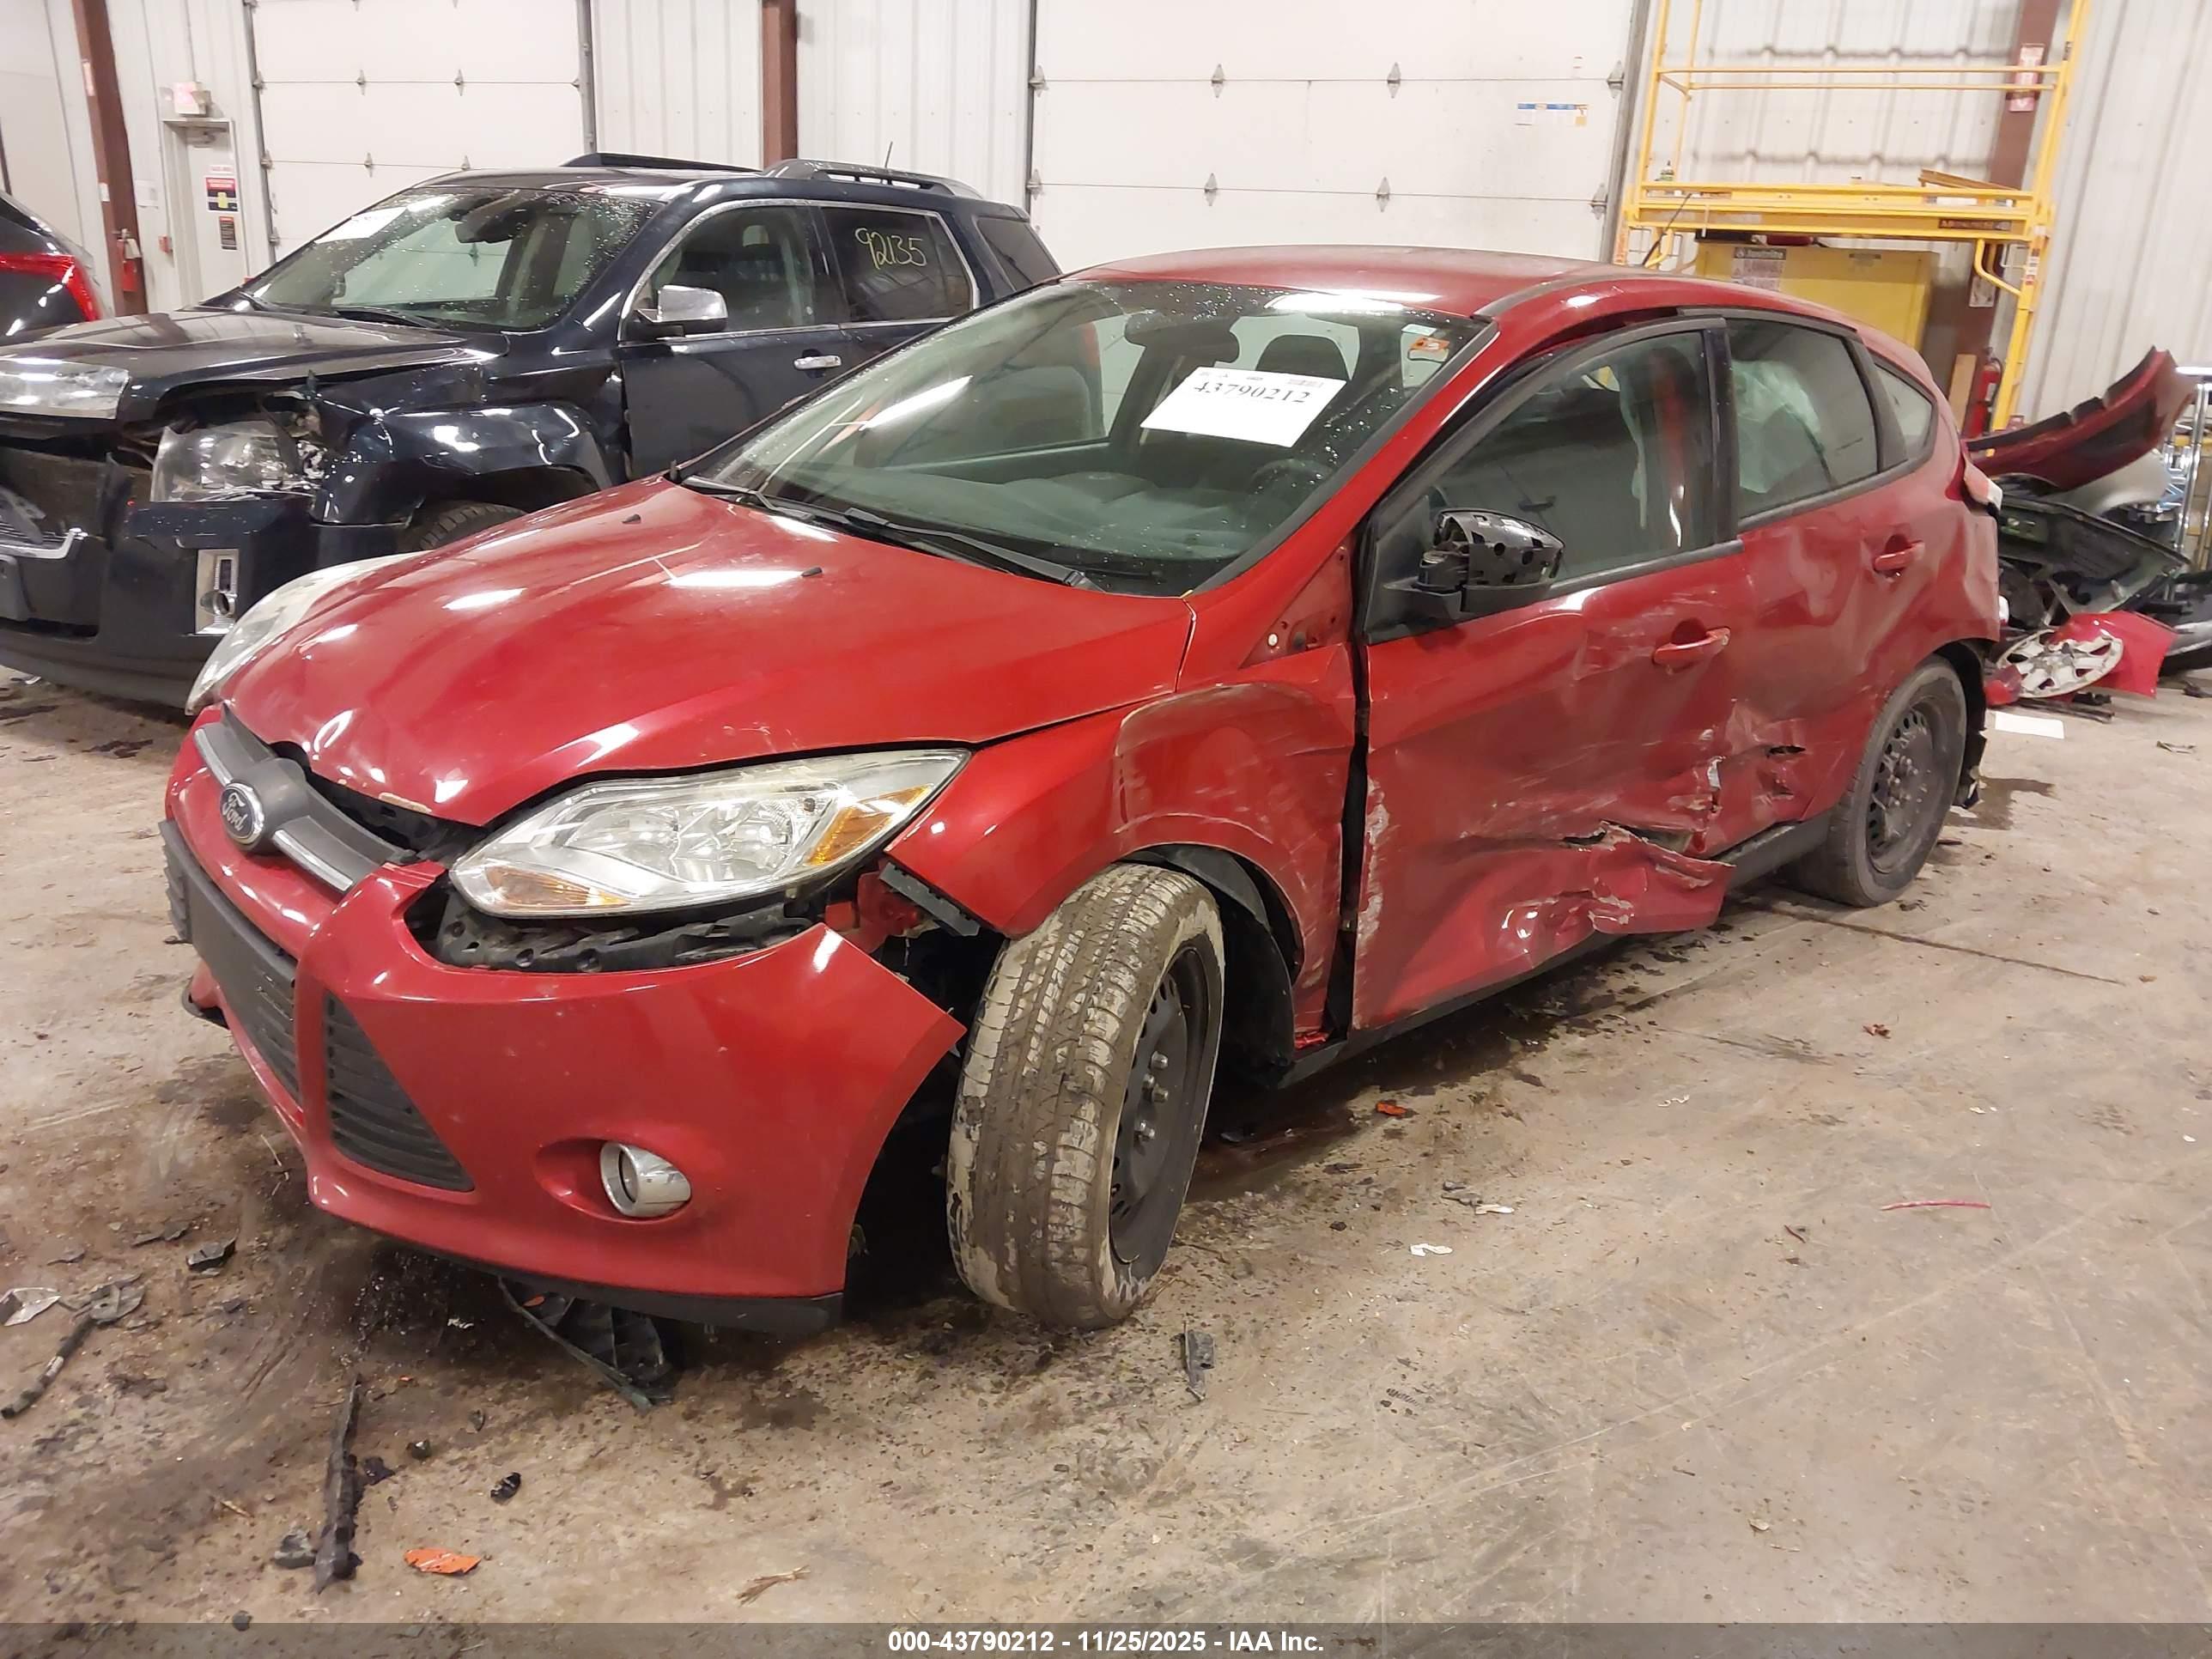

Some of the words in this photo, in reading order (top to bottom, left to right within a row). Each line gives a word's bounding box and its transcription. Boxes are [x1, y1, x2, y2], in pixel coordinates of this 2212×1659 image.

[854, 227, 927, 270] 92135
[1194, 381, 1310, 403] 43790212
[222, 792, 248, 832] Ford
